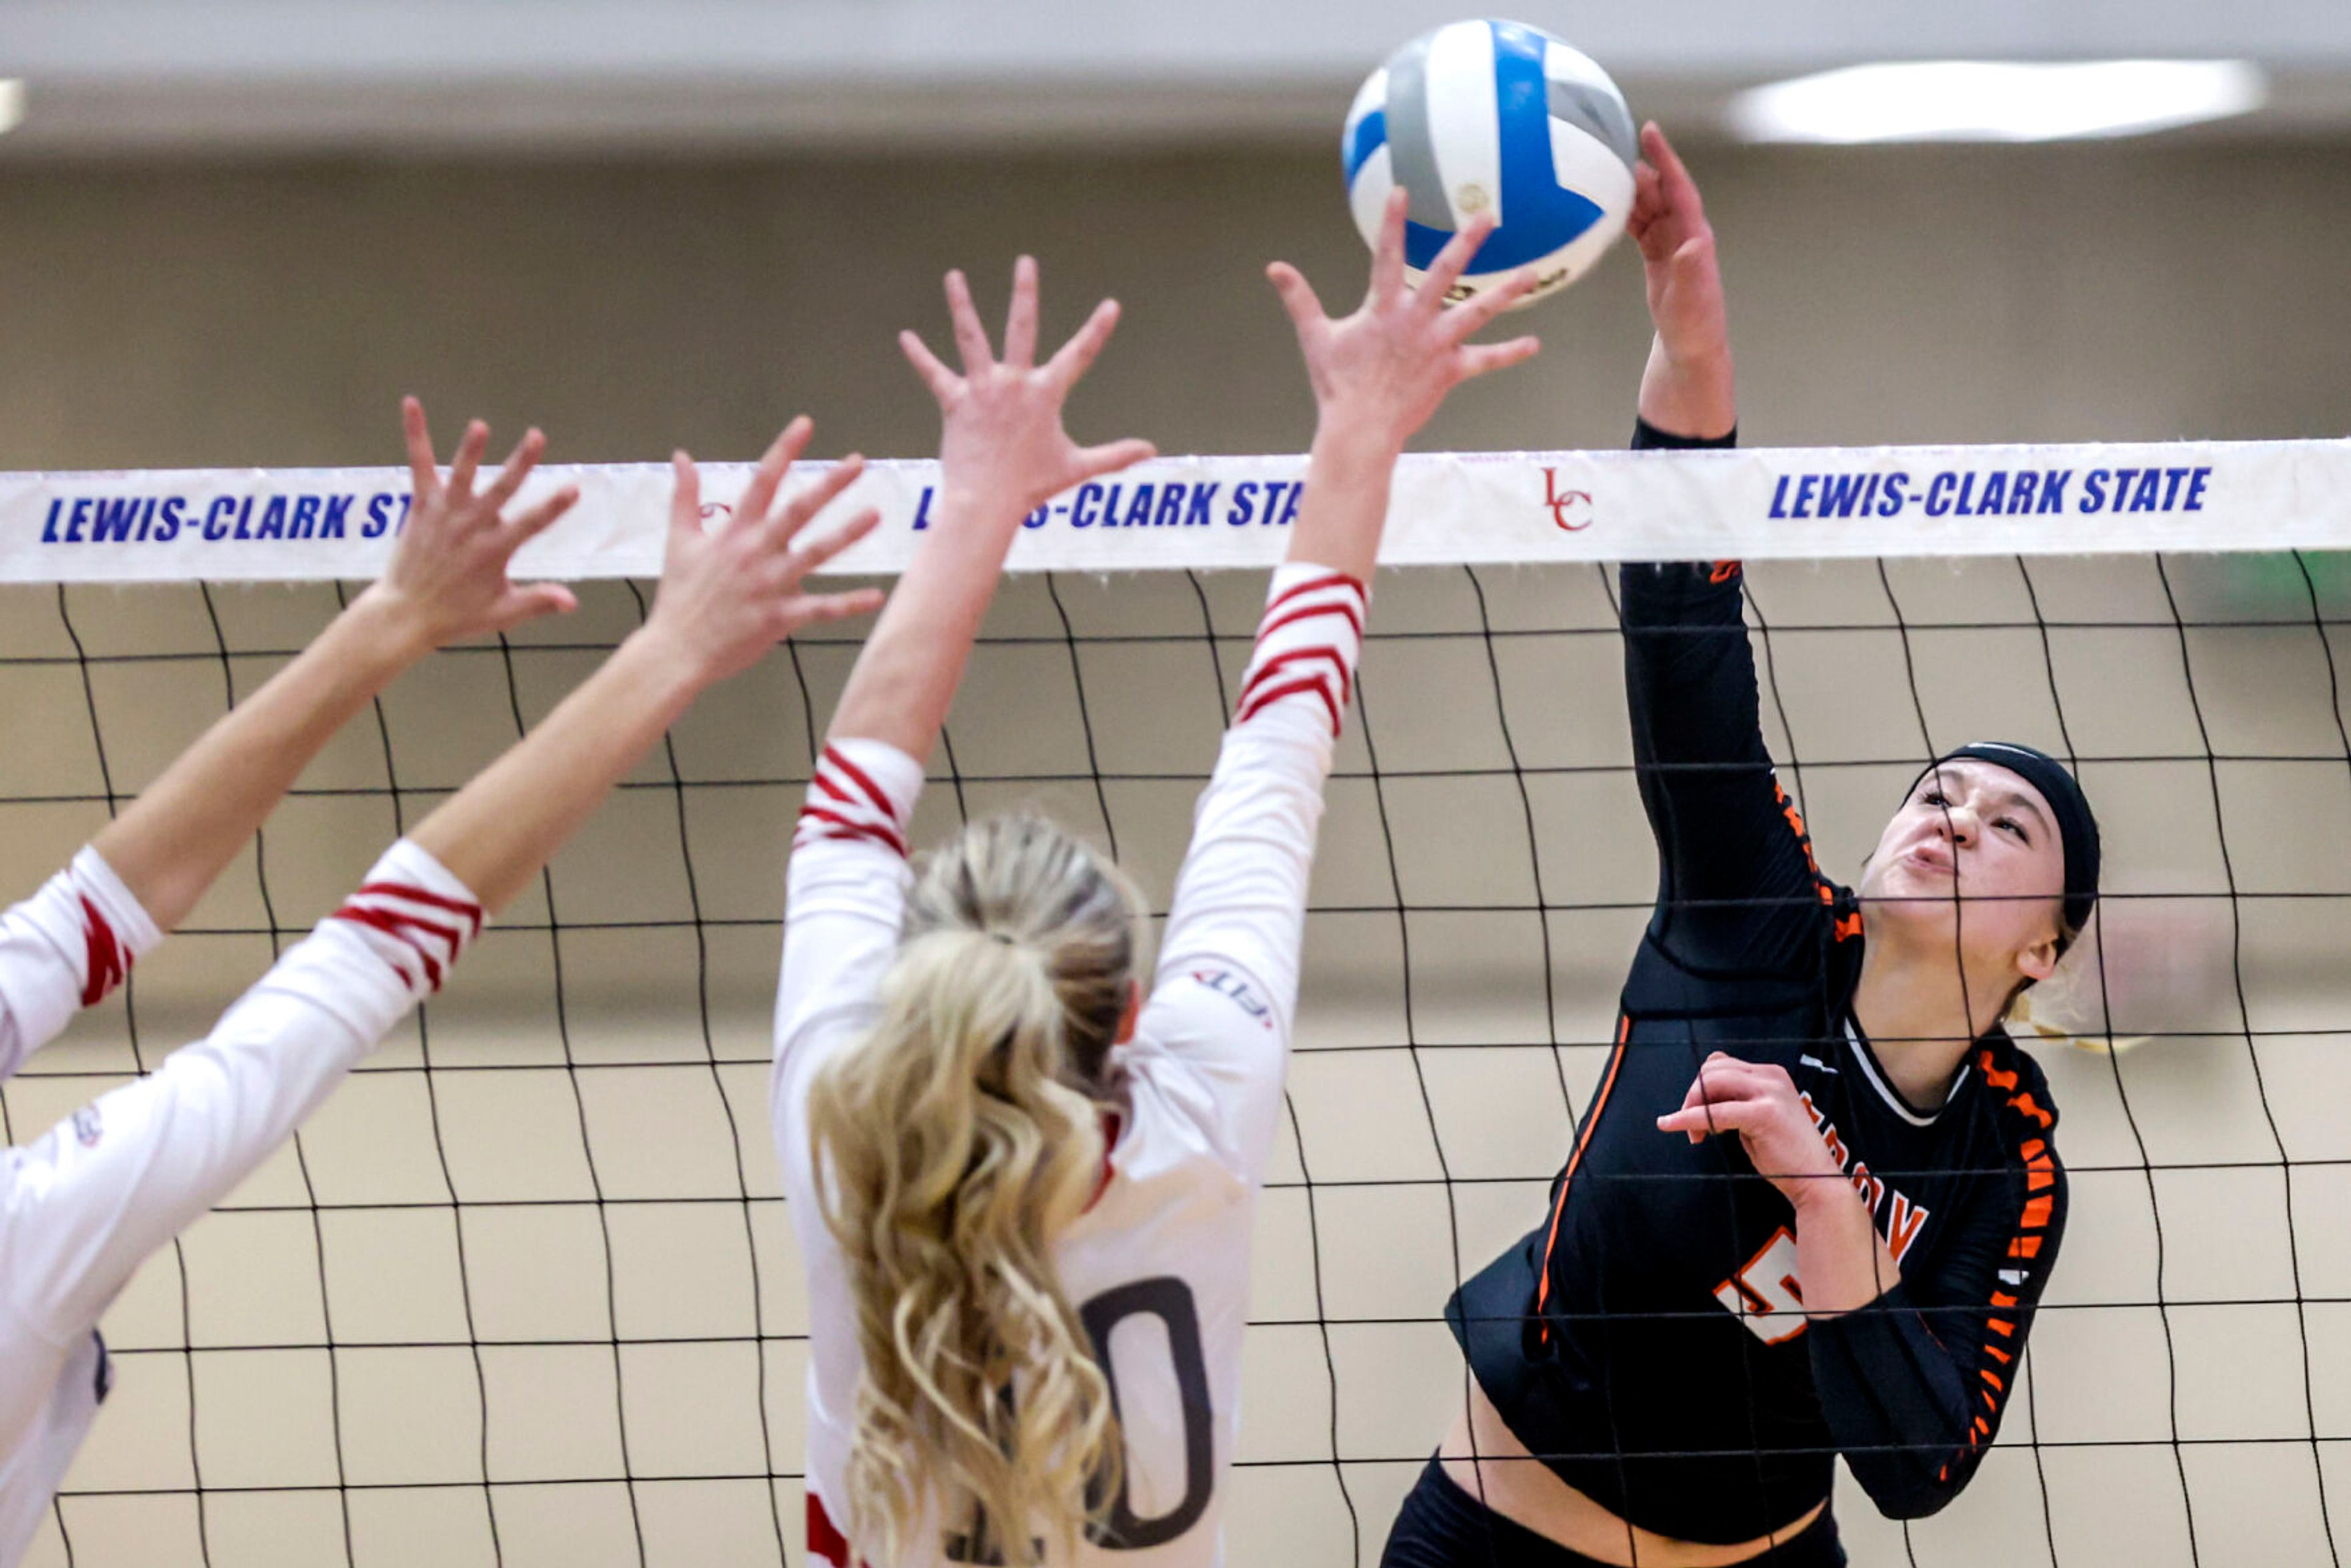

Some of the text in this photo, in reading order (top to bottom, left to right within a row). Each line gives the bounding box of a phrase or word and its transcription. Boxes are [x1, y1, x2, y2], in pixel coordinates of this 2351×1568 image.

[40, 492, 355, 544] LEWIS-CLARK
[912, 480, 1305, 531] L-CLARK STA
[1768, 467, 2213, 520] LEWIS-CLARK STATE
